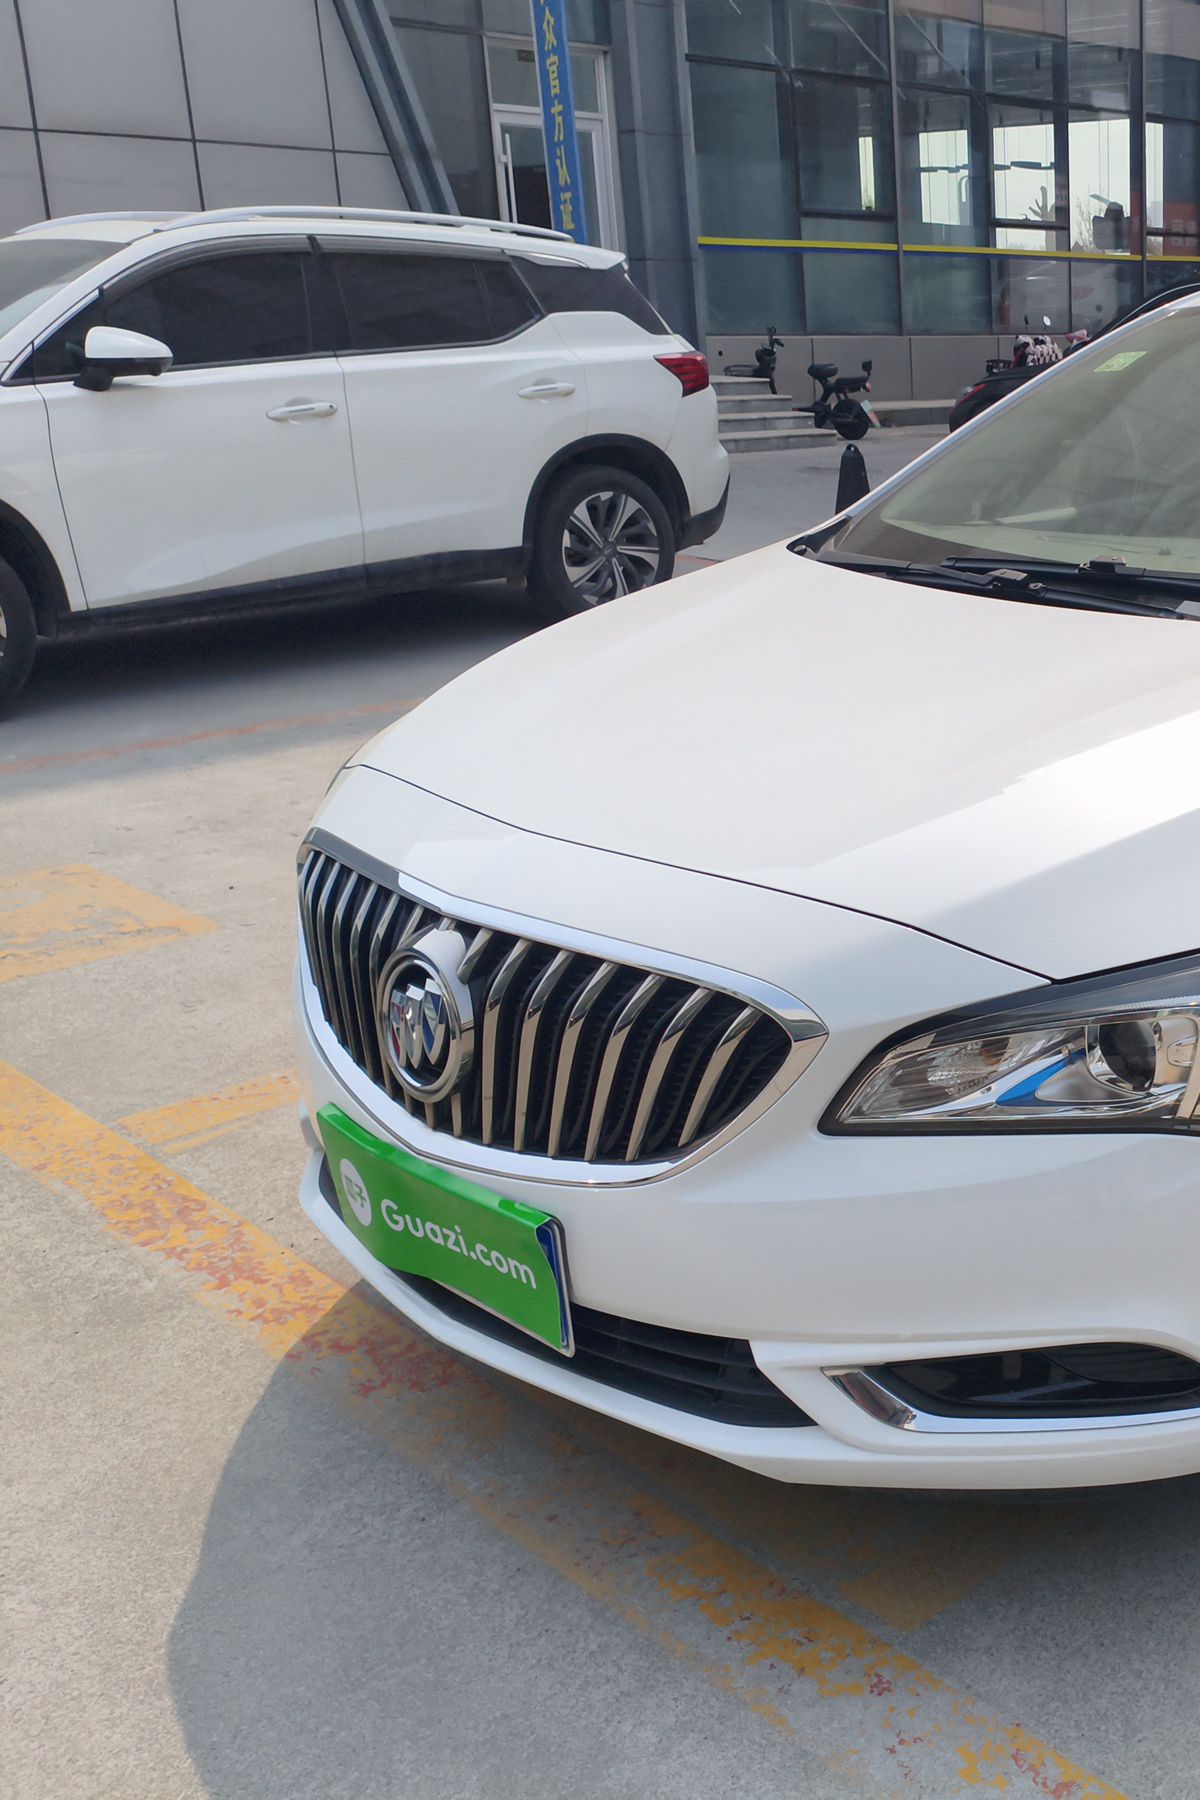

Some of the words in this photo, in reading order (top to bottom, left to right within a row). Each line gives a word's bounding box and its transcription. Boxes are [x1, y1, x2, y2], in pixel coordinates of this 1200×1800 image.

[540, 0, 576, 242] 众官方认证
[380, 1198, 537, 1290] Guazi.com
